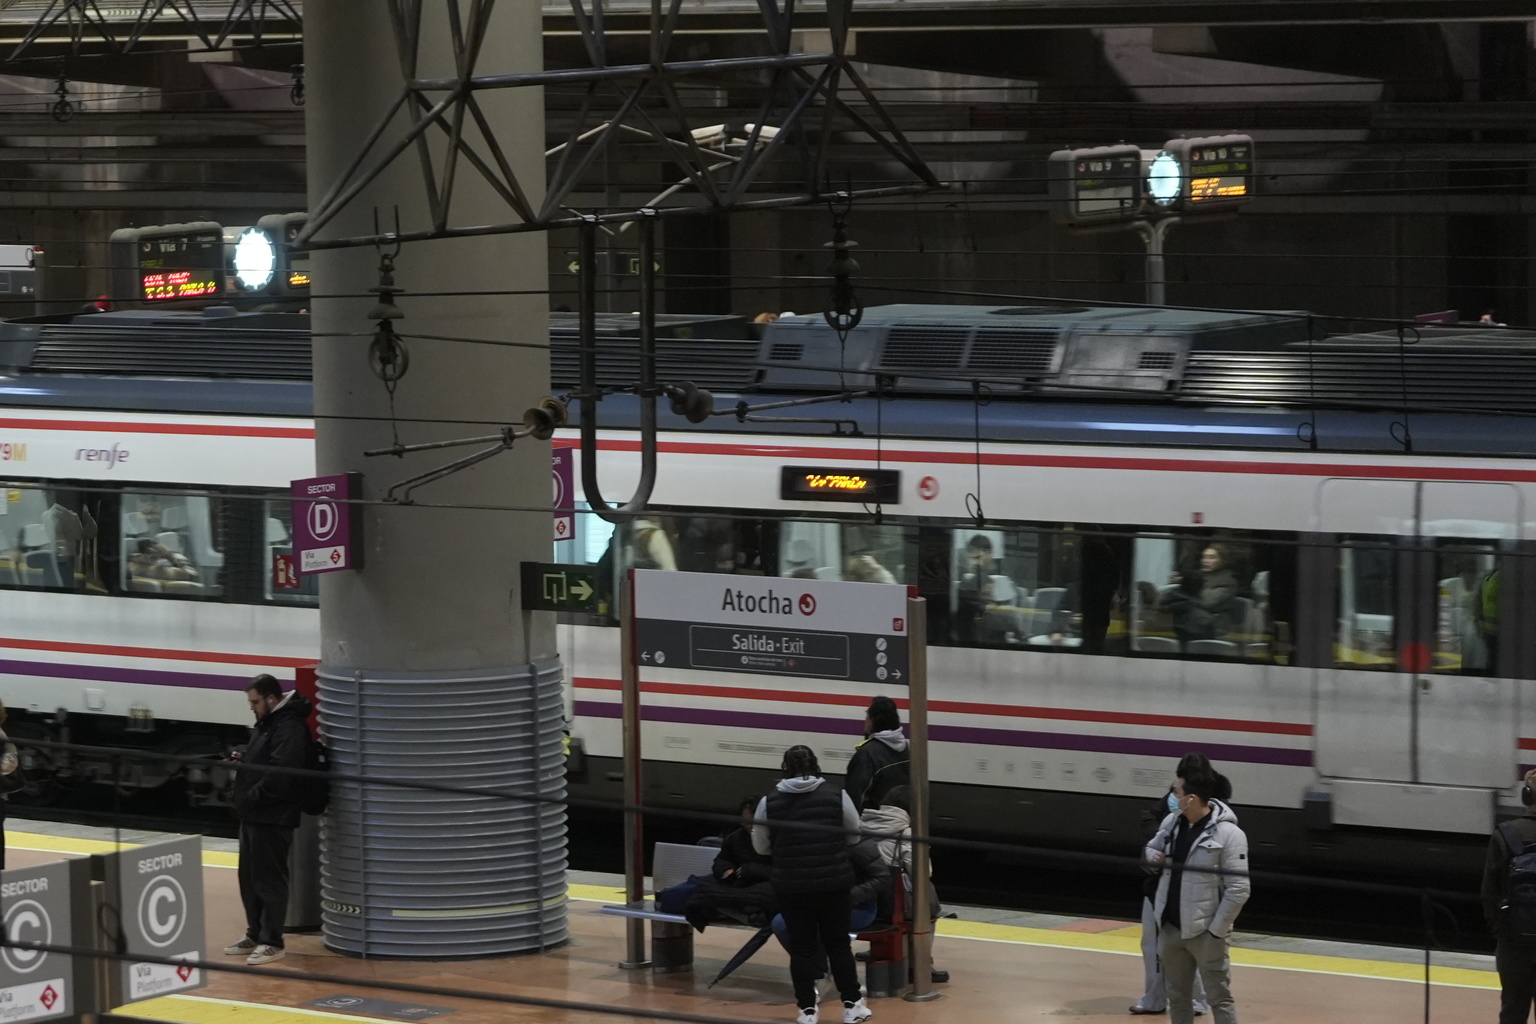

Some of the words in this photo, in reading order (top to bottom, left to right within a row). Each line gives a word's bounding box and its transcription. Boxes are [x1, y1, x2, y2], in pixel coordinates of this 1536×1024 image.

[74, 441, 130, 470] renfe
[307, 483, 336, 494] SECTOR
[314, 503, 333, 534] D
[332, 551, 339, 562] 5
[722, 588, 793, 615] Atocha
[137, 852, 183, 874] SECTOR
[0, 877, 48, 898] SECTOR
[148, 886, 177, 935] C
[10, 911, 41, 961] C
[181, 963, 189, 977] 4
[45, 989, 53, 1005] 3
